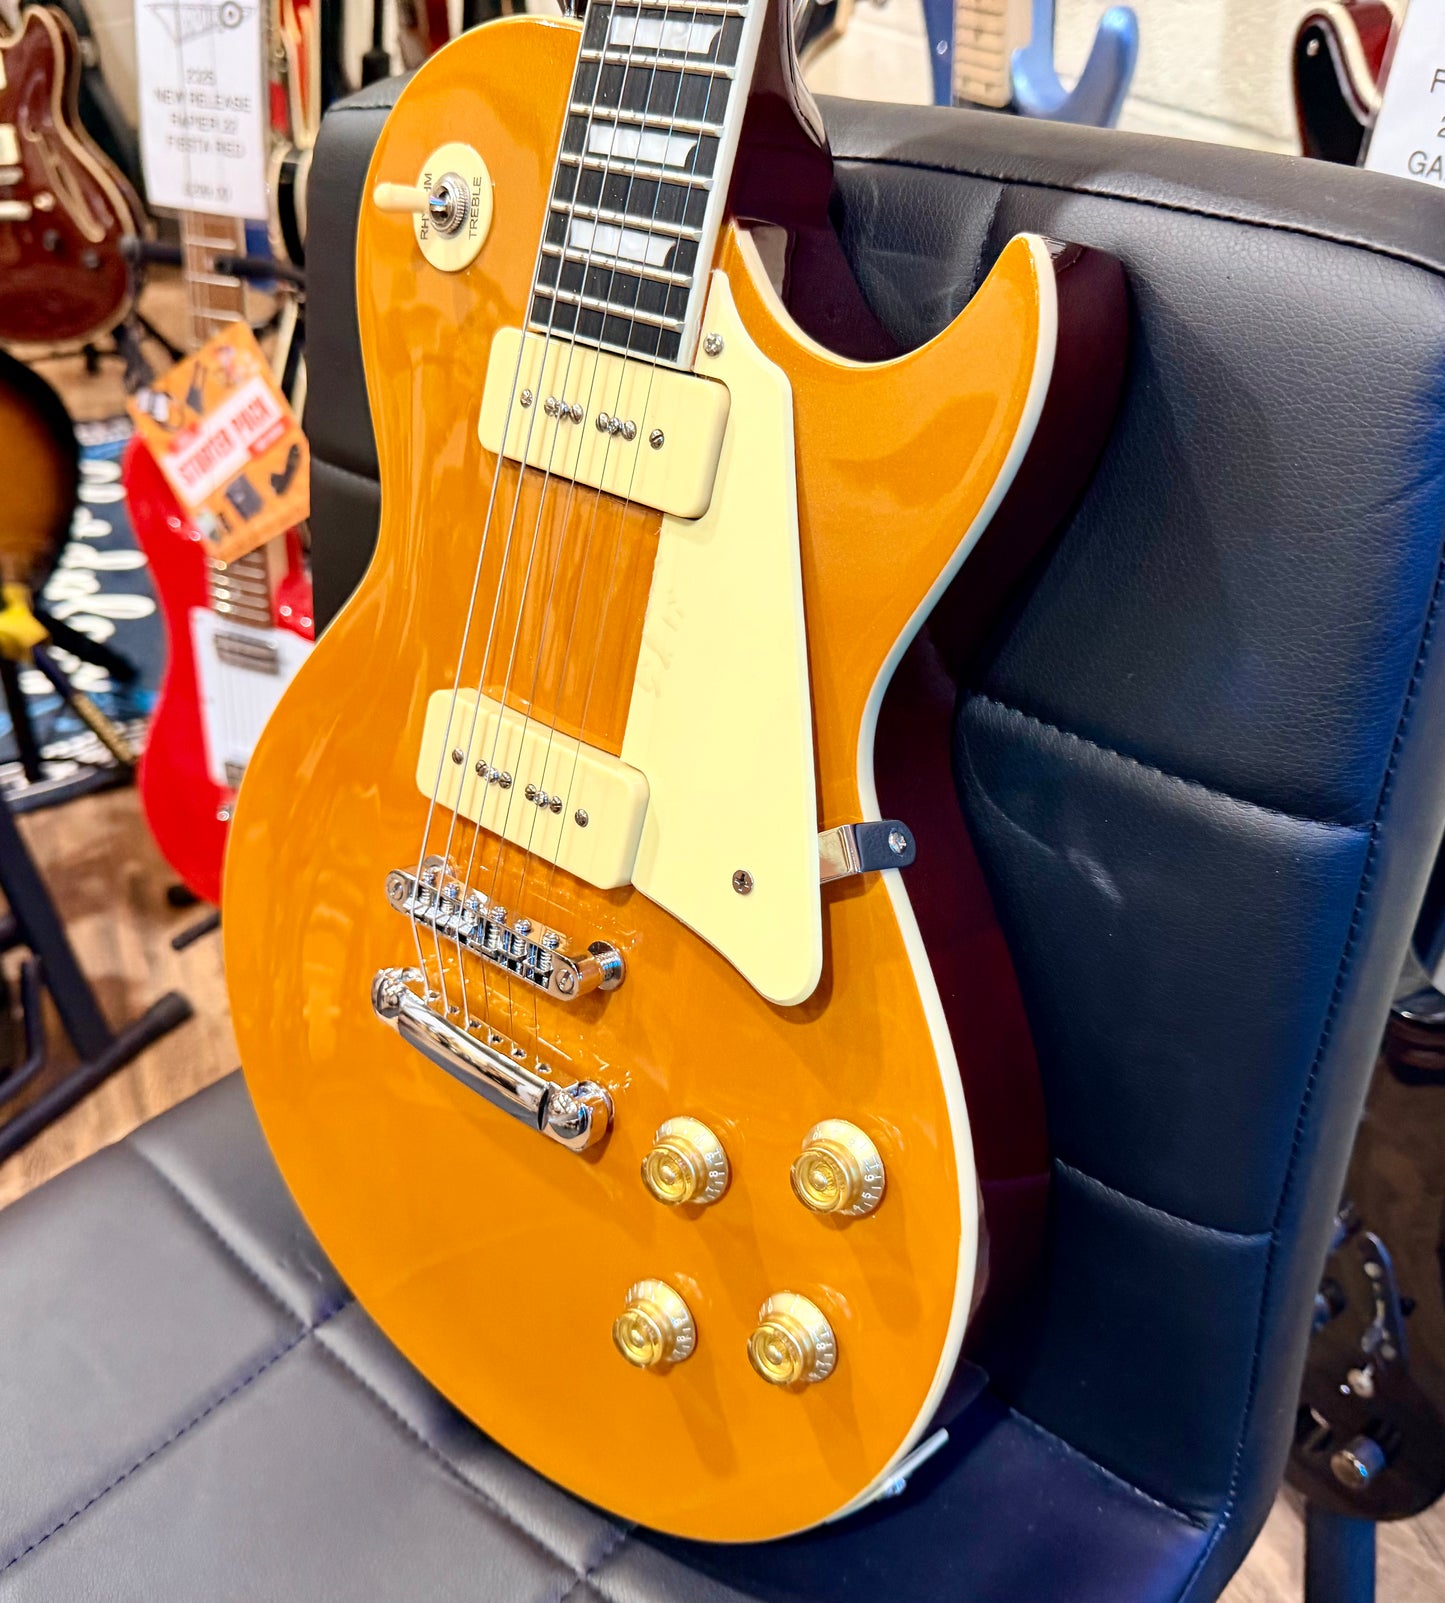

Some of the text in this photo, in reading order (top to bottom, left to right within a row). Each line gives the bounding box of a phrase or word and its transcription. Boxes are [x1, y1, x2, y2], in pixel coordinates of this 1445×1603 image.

[153, 86, 252, 113] NEW RELEASE
[215, 139, 246, 159] RED
[468, 177, 482, 240] TREBLE
[178, 428, 232, 488] STARTER
[230, 397, 271, 434] PACK
[816, 1342, 826, 1350] 8
